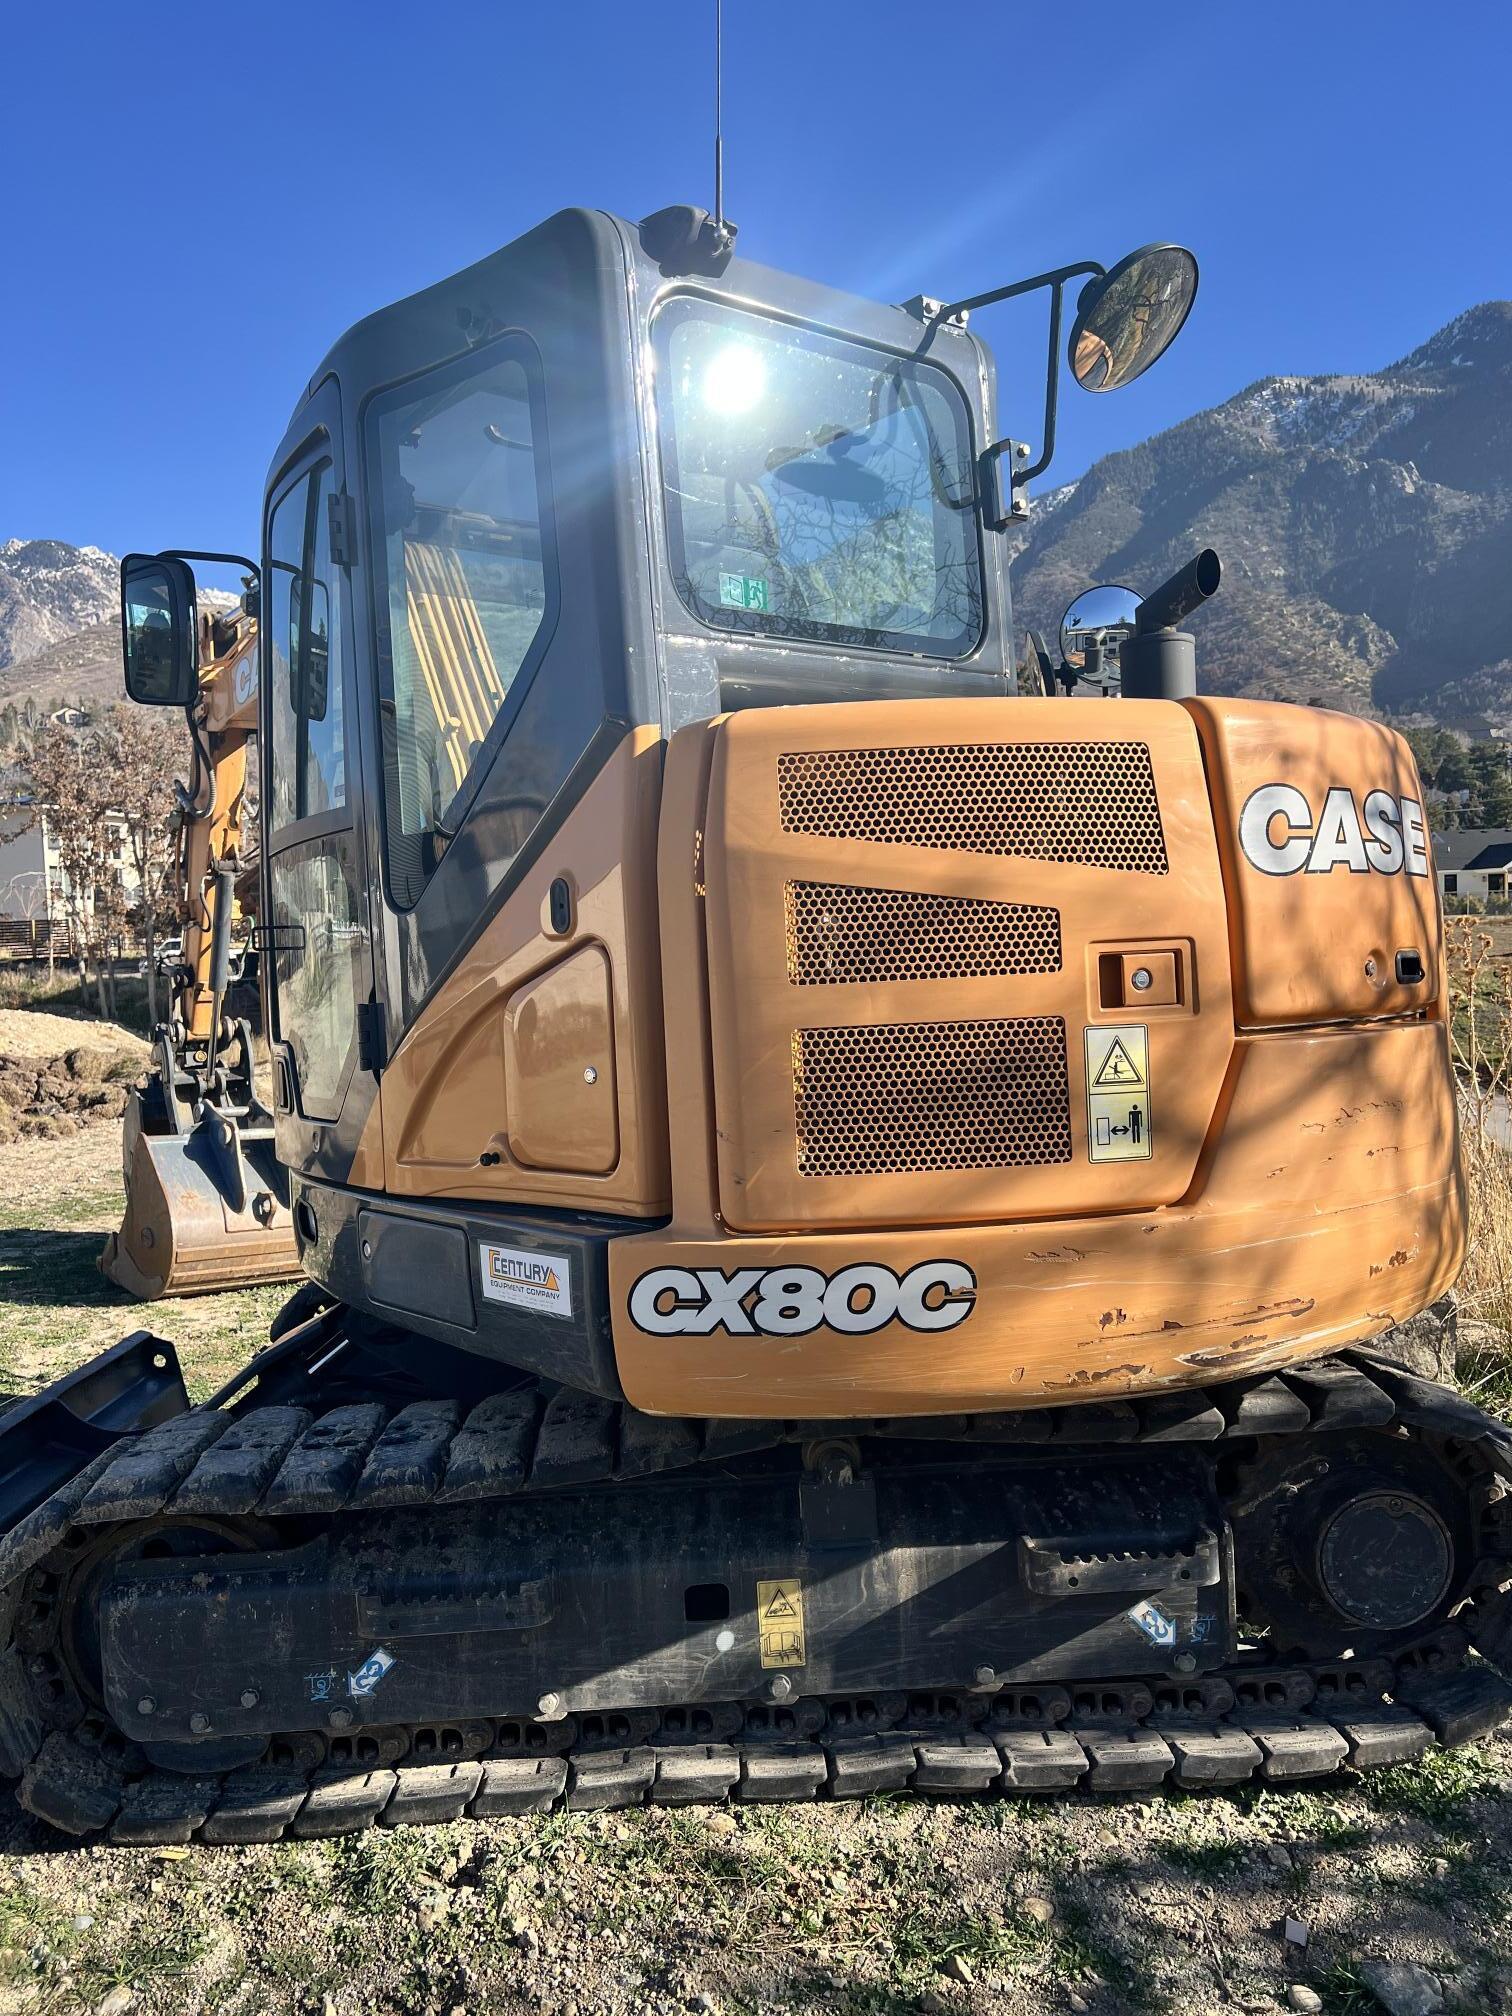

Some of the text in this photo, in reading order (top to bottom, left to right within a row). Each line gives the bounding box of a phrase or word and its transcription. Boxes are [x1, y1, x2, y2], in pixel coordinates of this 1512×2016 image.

[1239, 782, 1428, 878] CASE
[490, 1279, 525, 1294] EQUIPMENT
[526, 1286, 560, 1301] COMPANY
[491, 1254, 550, 1283] CENTURY
[628, 1259, 977, 1337] CX80C
